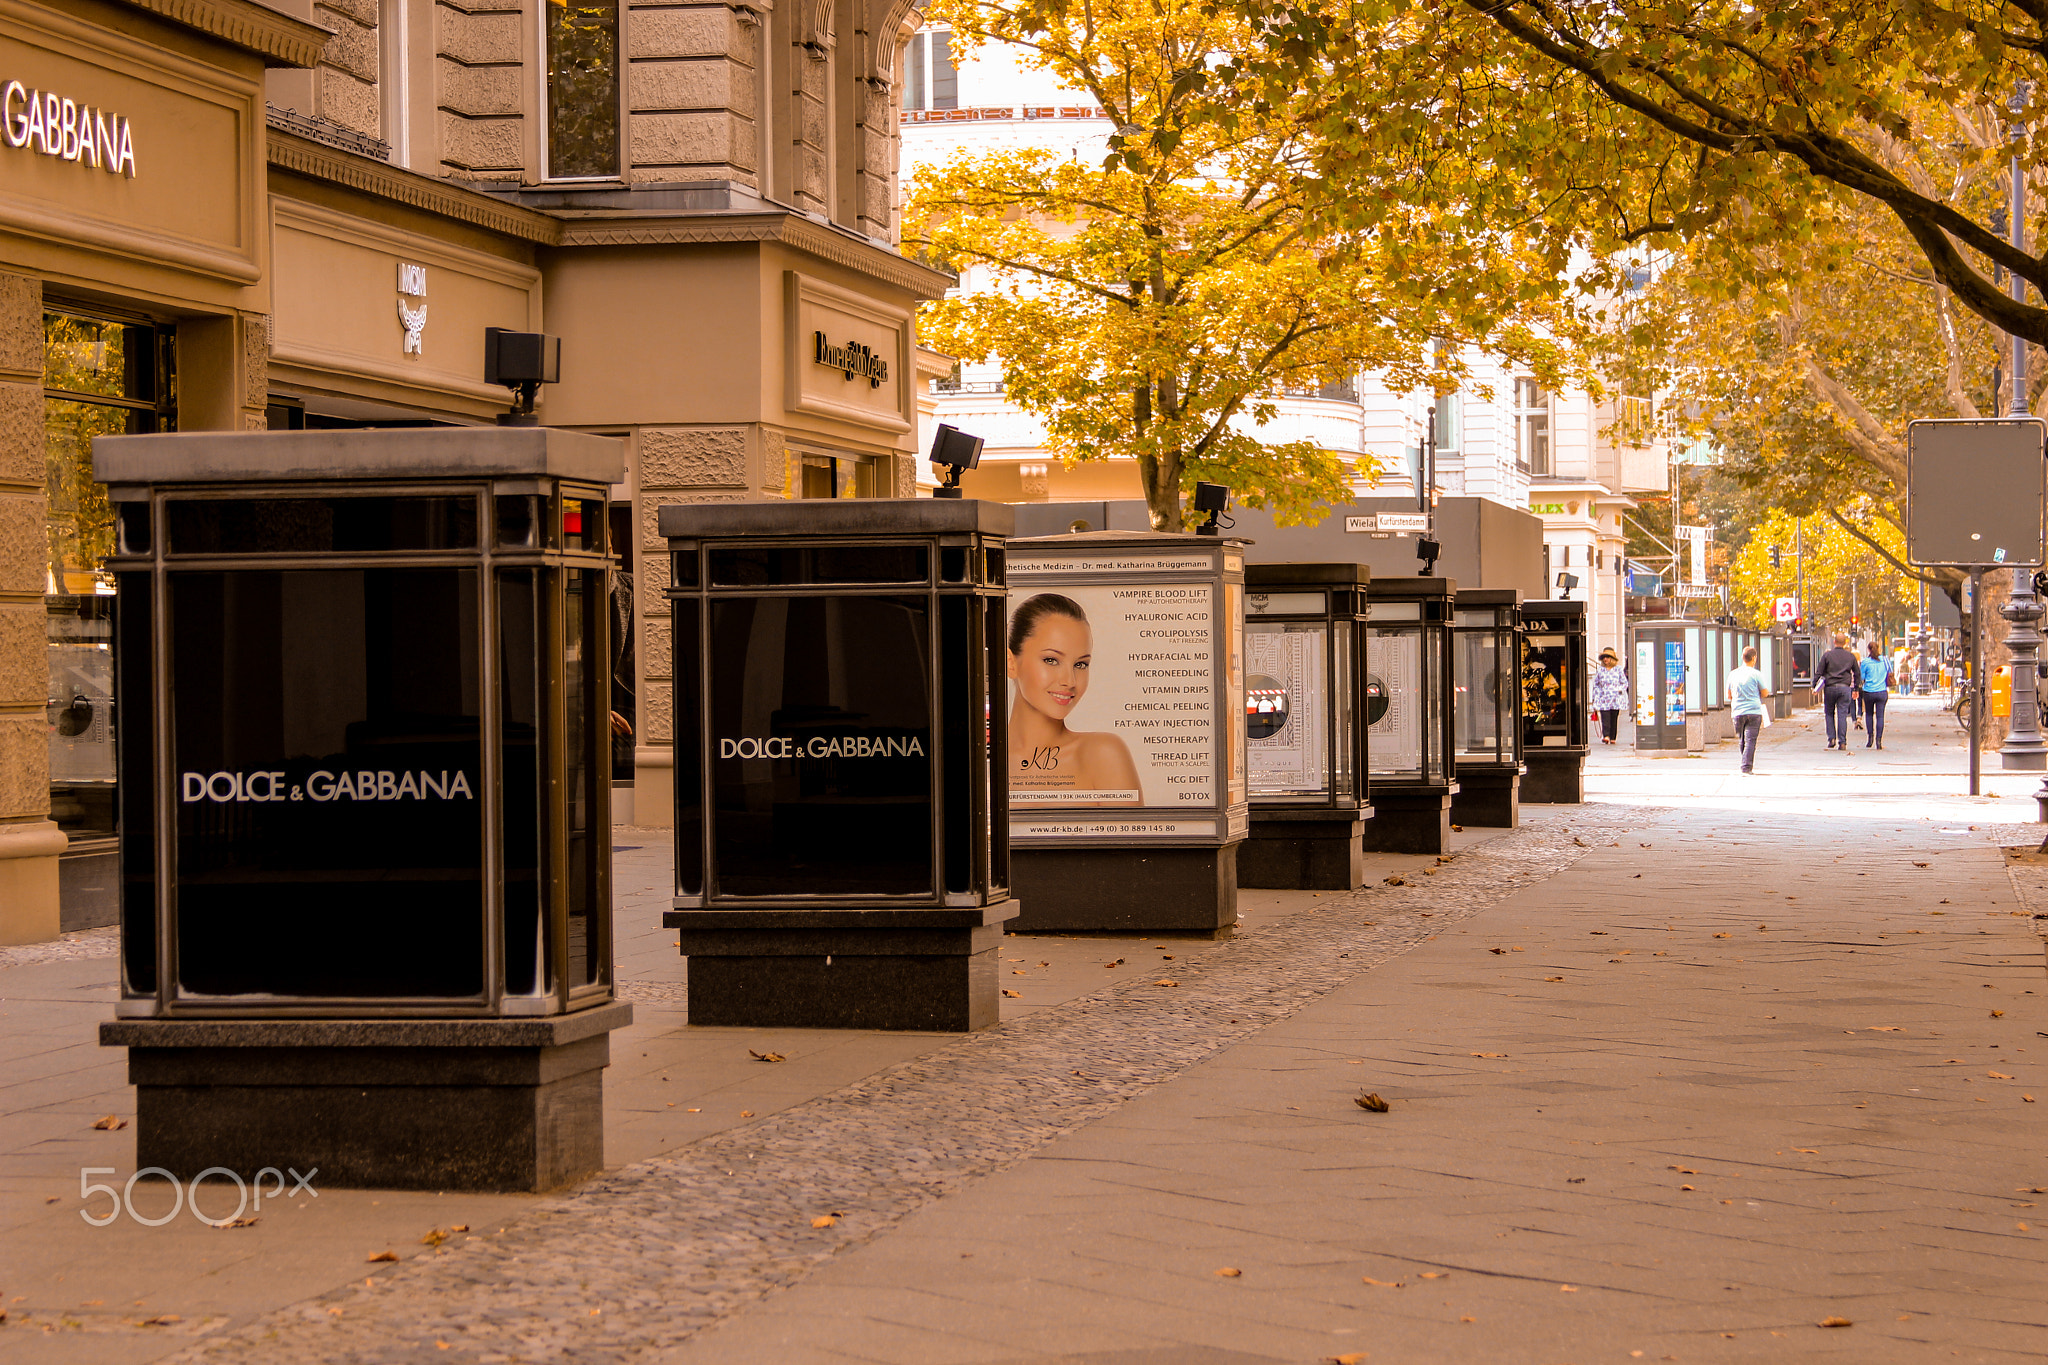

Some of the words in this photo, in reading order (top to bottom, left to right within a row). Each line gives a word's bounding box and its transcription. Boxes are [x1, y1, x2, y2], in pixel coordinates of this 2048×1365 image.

[2, 80, 137, 178] GABBANA
[400, 263, 427, 296] MCM
[1379, 515, 1425, 527] Kurfürstendamm
[1043, 562, 1074, 570] Medizin
[1082, 562, 1094, 570] Dr.
[1117, 561, 1155, 569] Katharina
[1157, 561, 1207, 569] Brüggemann
[1112, 590, 1153, 598] VAMPIRE
[1155, 590, 1187, 598] BLOOD
[1189, 589, 1207, 597] LIFT
[1250, 594, 1269, 602] MCM
[1124, 613, 1184, 621] HYALURONIC
[1186, 612, 1208, 620] ACID
[1139, 629, 1209, 638] CRYOLIPOLYSIS
[1128, 653, 1191, 661] HYDRAFACIAL
[1194, 652, 1209, 660] MD
[1135, 669, 1209, 677] MICRONEEDLING
[1142, 686, 1181, 694] VITAMIN
[1183, 686, 1209, 694] DRIPS
[1124, 703, 1170, 711] CHEMICAL
[1173, 702, 1210, 710] PEELING
[1114, 720, 1160, 728] FAT-AWAY
[1163, 719, 1210, 728] INJECTION
[1143, 736, 1209, 744] MESOTHERAPY
[720, 737, 793, 759] DOLCE
[795, 746, 806, 759] &
[807, 736, 925, 758] GABBANA
[1020, 745, 1060, 771] KB
[1151, 752, 1188, 760] THREAD
[1190, 752, 1209, 760] LIFT
[1167, 775, 1186, 784] HCG
[1189, 775, 1210, 783] DIET
[183, 771, 286, 802] DOLCE
[290, 784, 304, 801] &
[306, 770, 473, 801] GABBANA
[1178, 792, 1210, 800] BOTOX
[1030, 825, 1083, 833] www.dr-kb.de
[1090, 825, 1104, 833] +49
[1106, 825, 1117, 833] (0)
[1149, 824, 1163, 832] 145
[1165, 824, 1176, 832] 80
